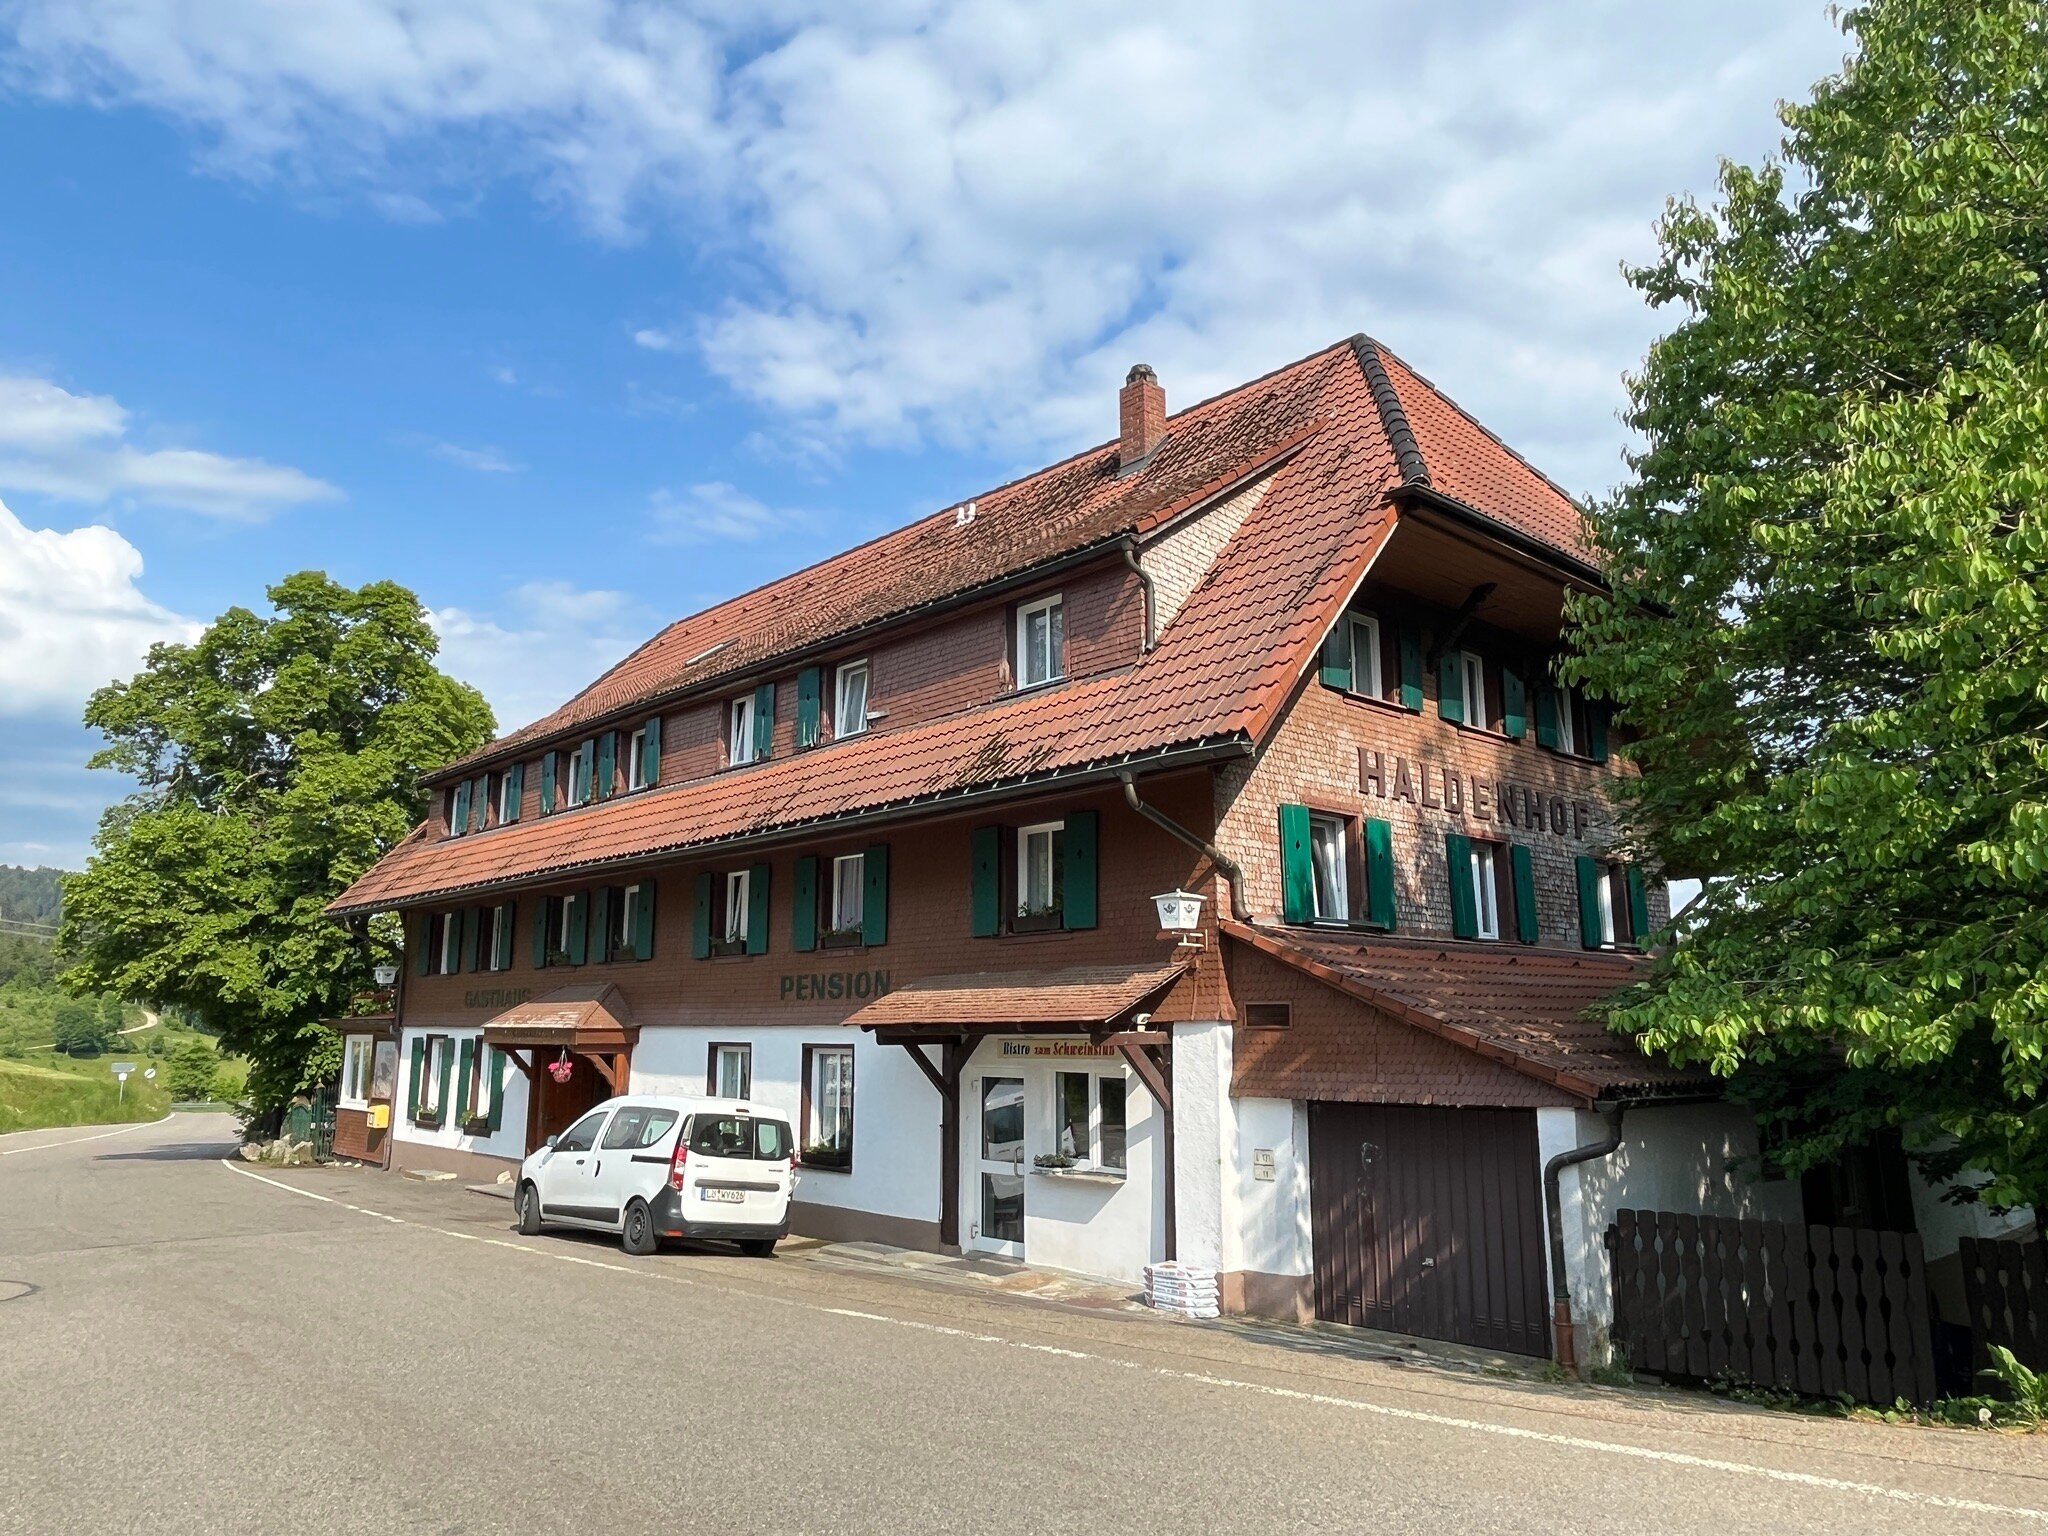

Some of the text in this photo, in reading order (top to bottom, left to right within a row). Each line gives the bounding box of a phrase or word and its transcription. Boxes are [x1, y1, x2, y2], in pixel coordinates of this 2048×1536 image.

[1357, 747, 1588, 840] HALDENHOF
[780, 969, 890, 1000] PENSION
[1003, 1042, 1031, 1055] Bistro
[1034, 1047, 1051, 1055] zum
